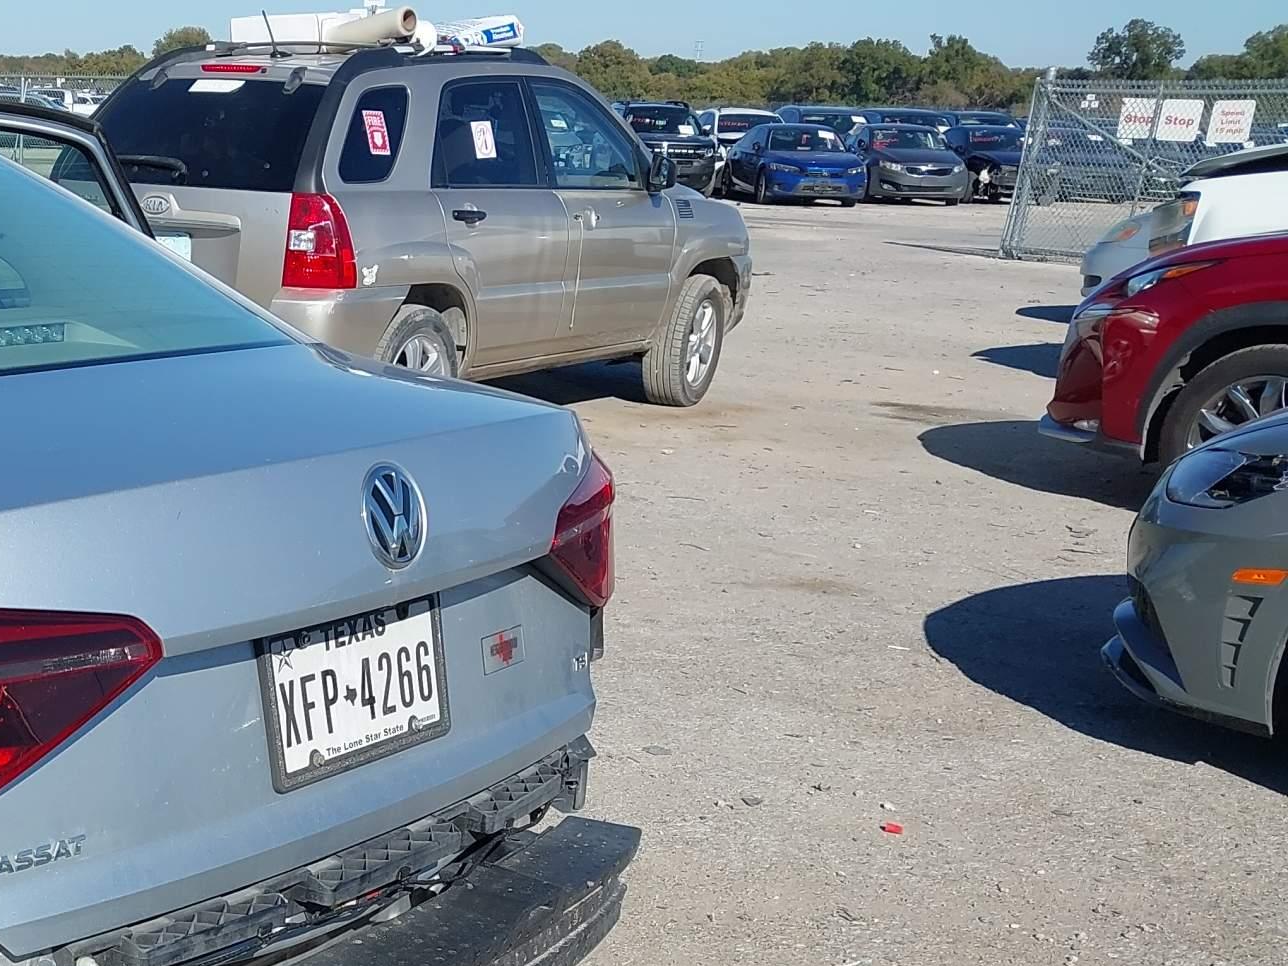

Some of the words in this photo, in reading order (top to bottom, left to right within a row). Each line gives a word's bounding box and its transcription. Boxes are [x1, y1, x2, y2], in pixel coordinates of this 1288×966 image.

[1124, 114, 1154, 126] Stop
[1164, 115, 1194, 128] Stop
[320, 612, 386, 652] TEXAS
[326, 746, 342, 757] The
[343, 739, 363, 751] Lone
[365, 732, 382, 743] Star
[383, 724, 404, 737] State
